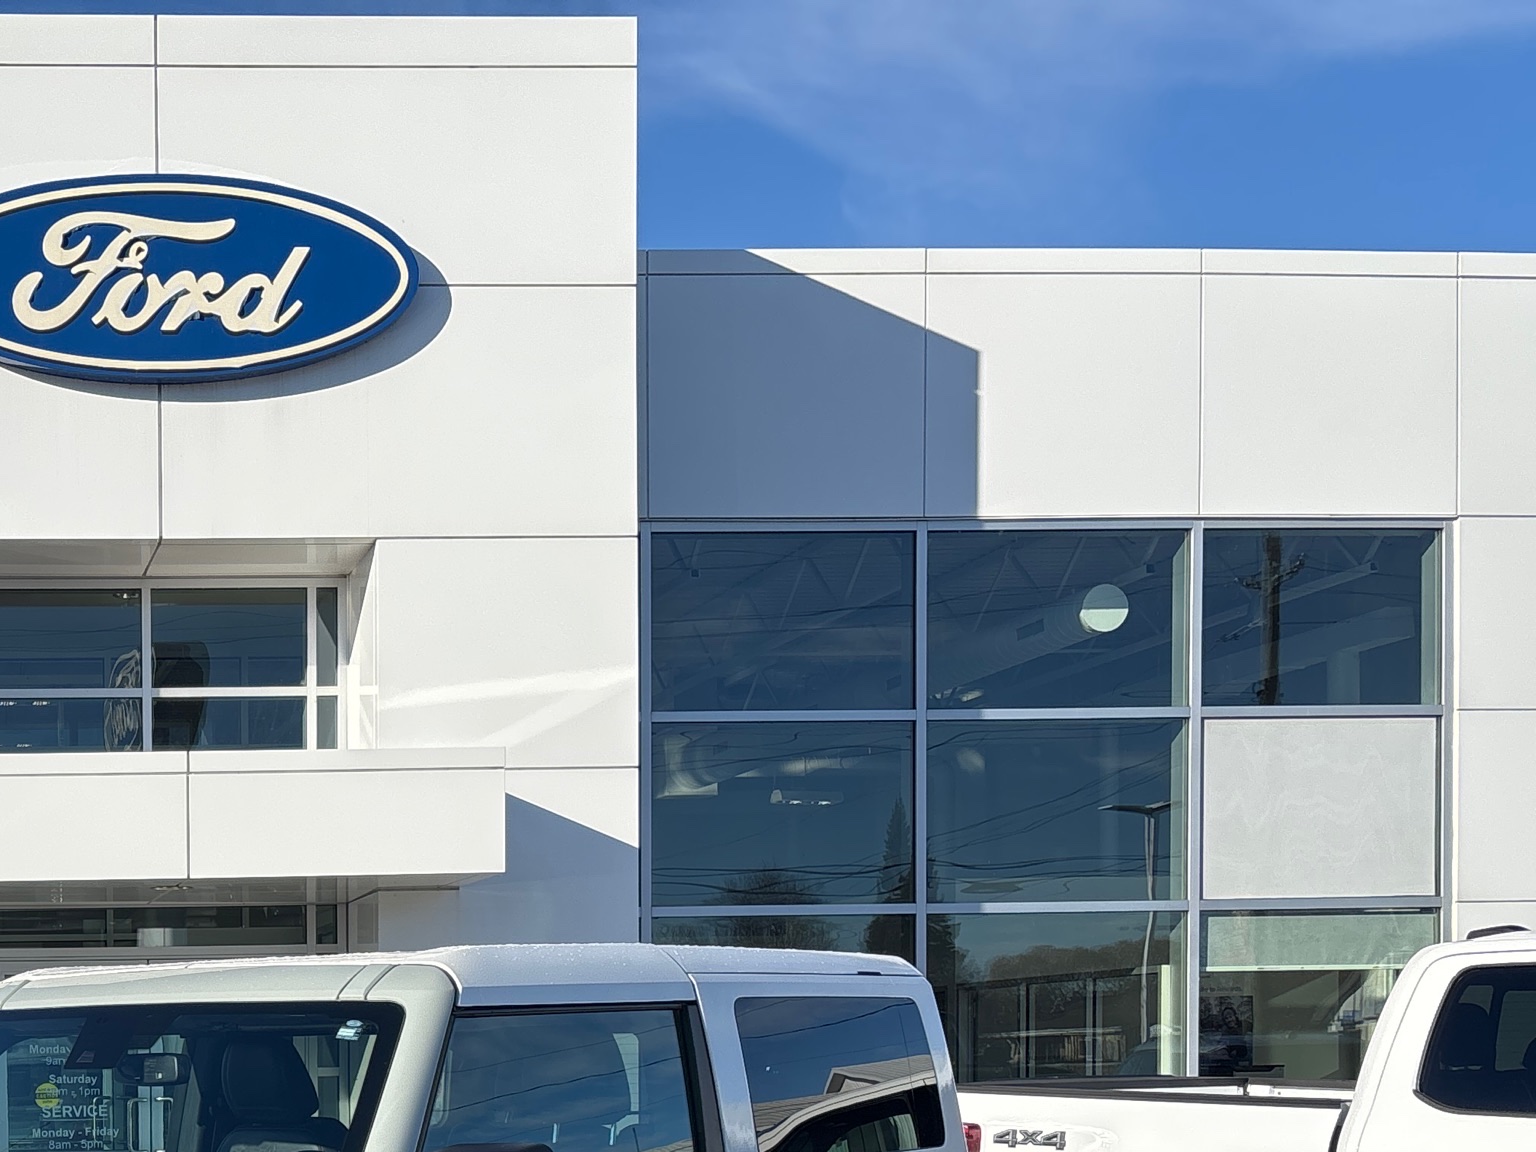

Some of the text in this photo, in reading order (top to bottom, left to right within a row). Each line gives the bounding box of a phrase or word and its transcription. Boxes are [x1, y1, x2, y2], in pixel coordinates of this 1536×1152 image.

[12, 211, 310, 333] Ford
[48, 1074, 98, 1087] Saturday
[79, 1087, 101, 1098] 1pm
[42, 1104, 108, 1118] SERVICE
[32, 1127, 75, 1139] Monday
[85, 1126, 119, 1138] Friday
[48, 1139, 71, 1150] 8am
[80, 1139, 103, 1151] 5pm
